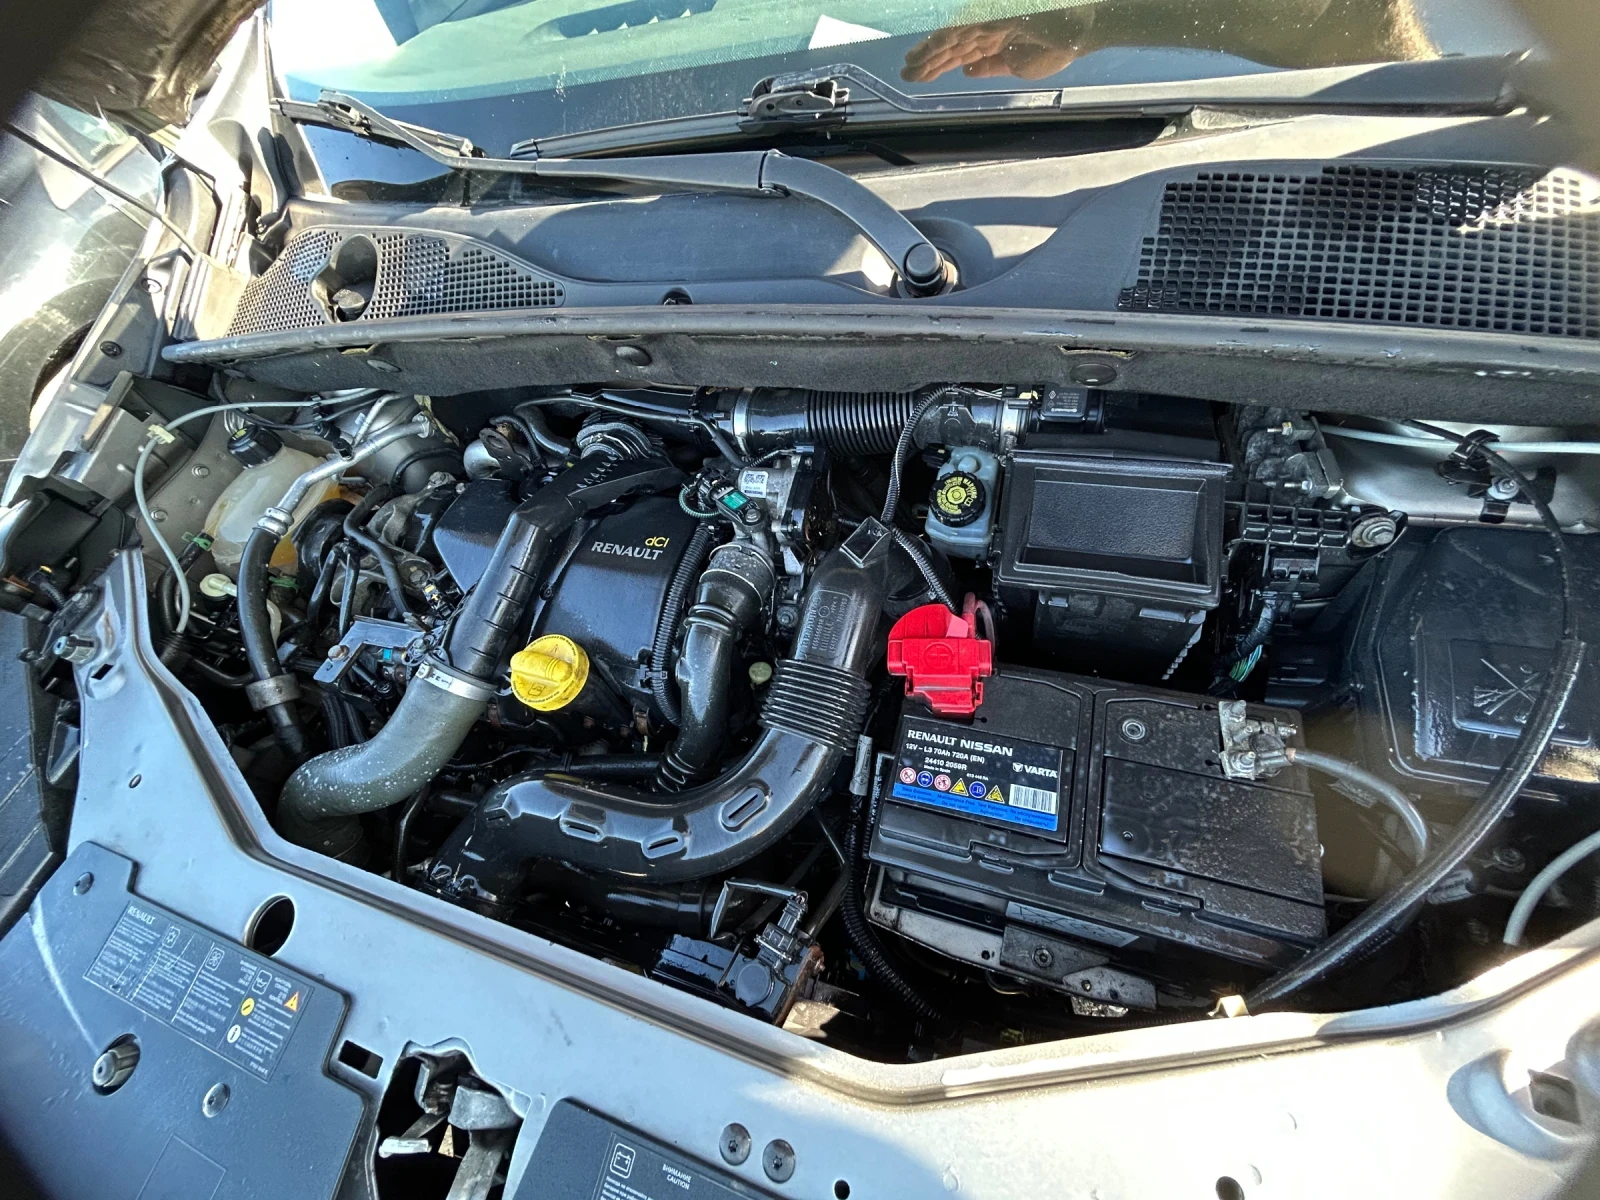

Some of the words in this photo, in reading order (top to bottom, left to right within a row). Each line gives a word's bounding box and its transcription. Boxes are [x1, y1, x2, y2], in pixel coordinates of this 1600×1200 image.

[591, 541, 663, 560] RENAULT
[907, 729, 958, 746] RENAULT
[960, 738, 1013, 757] NISSAN
[905, 742, 918, 750] 12V
[923, 746, 933, 754] L3
[933, 748, 951, 757] 70Ah
[951, 751, 969, 761] 720A
[970, 755, 985, 764] (EN)
[924, 756, 945, 766] 24410
[1024, 765, 1057, 779] VARTA
[128, 905, 155, 925] RENAULT
[662, 1164, 692, 1183] ВНИМАНИЕ
[666, 1174, 690, 1190] CAUTION
